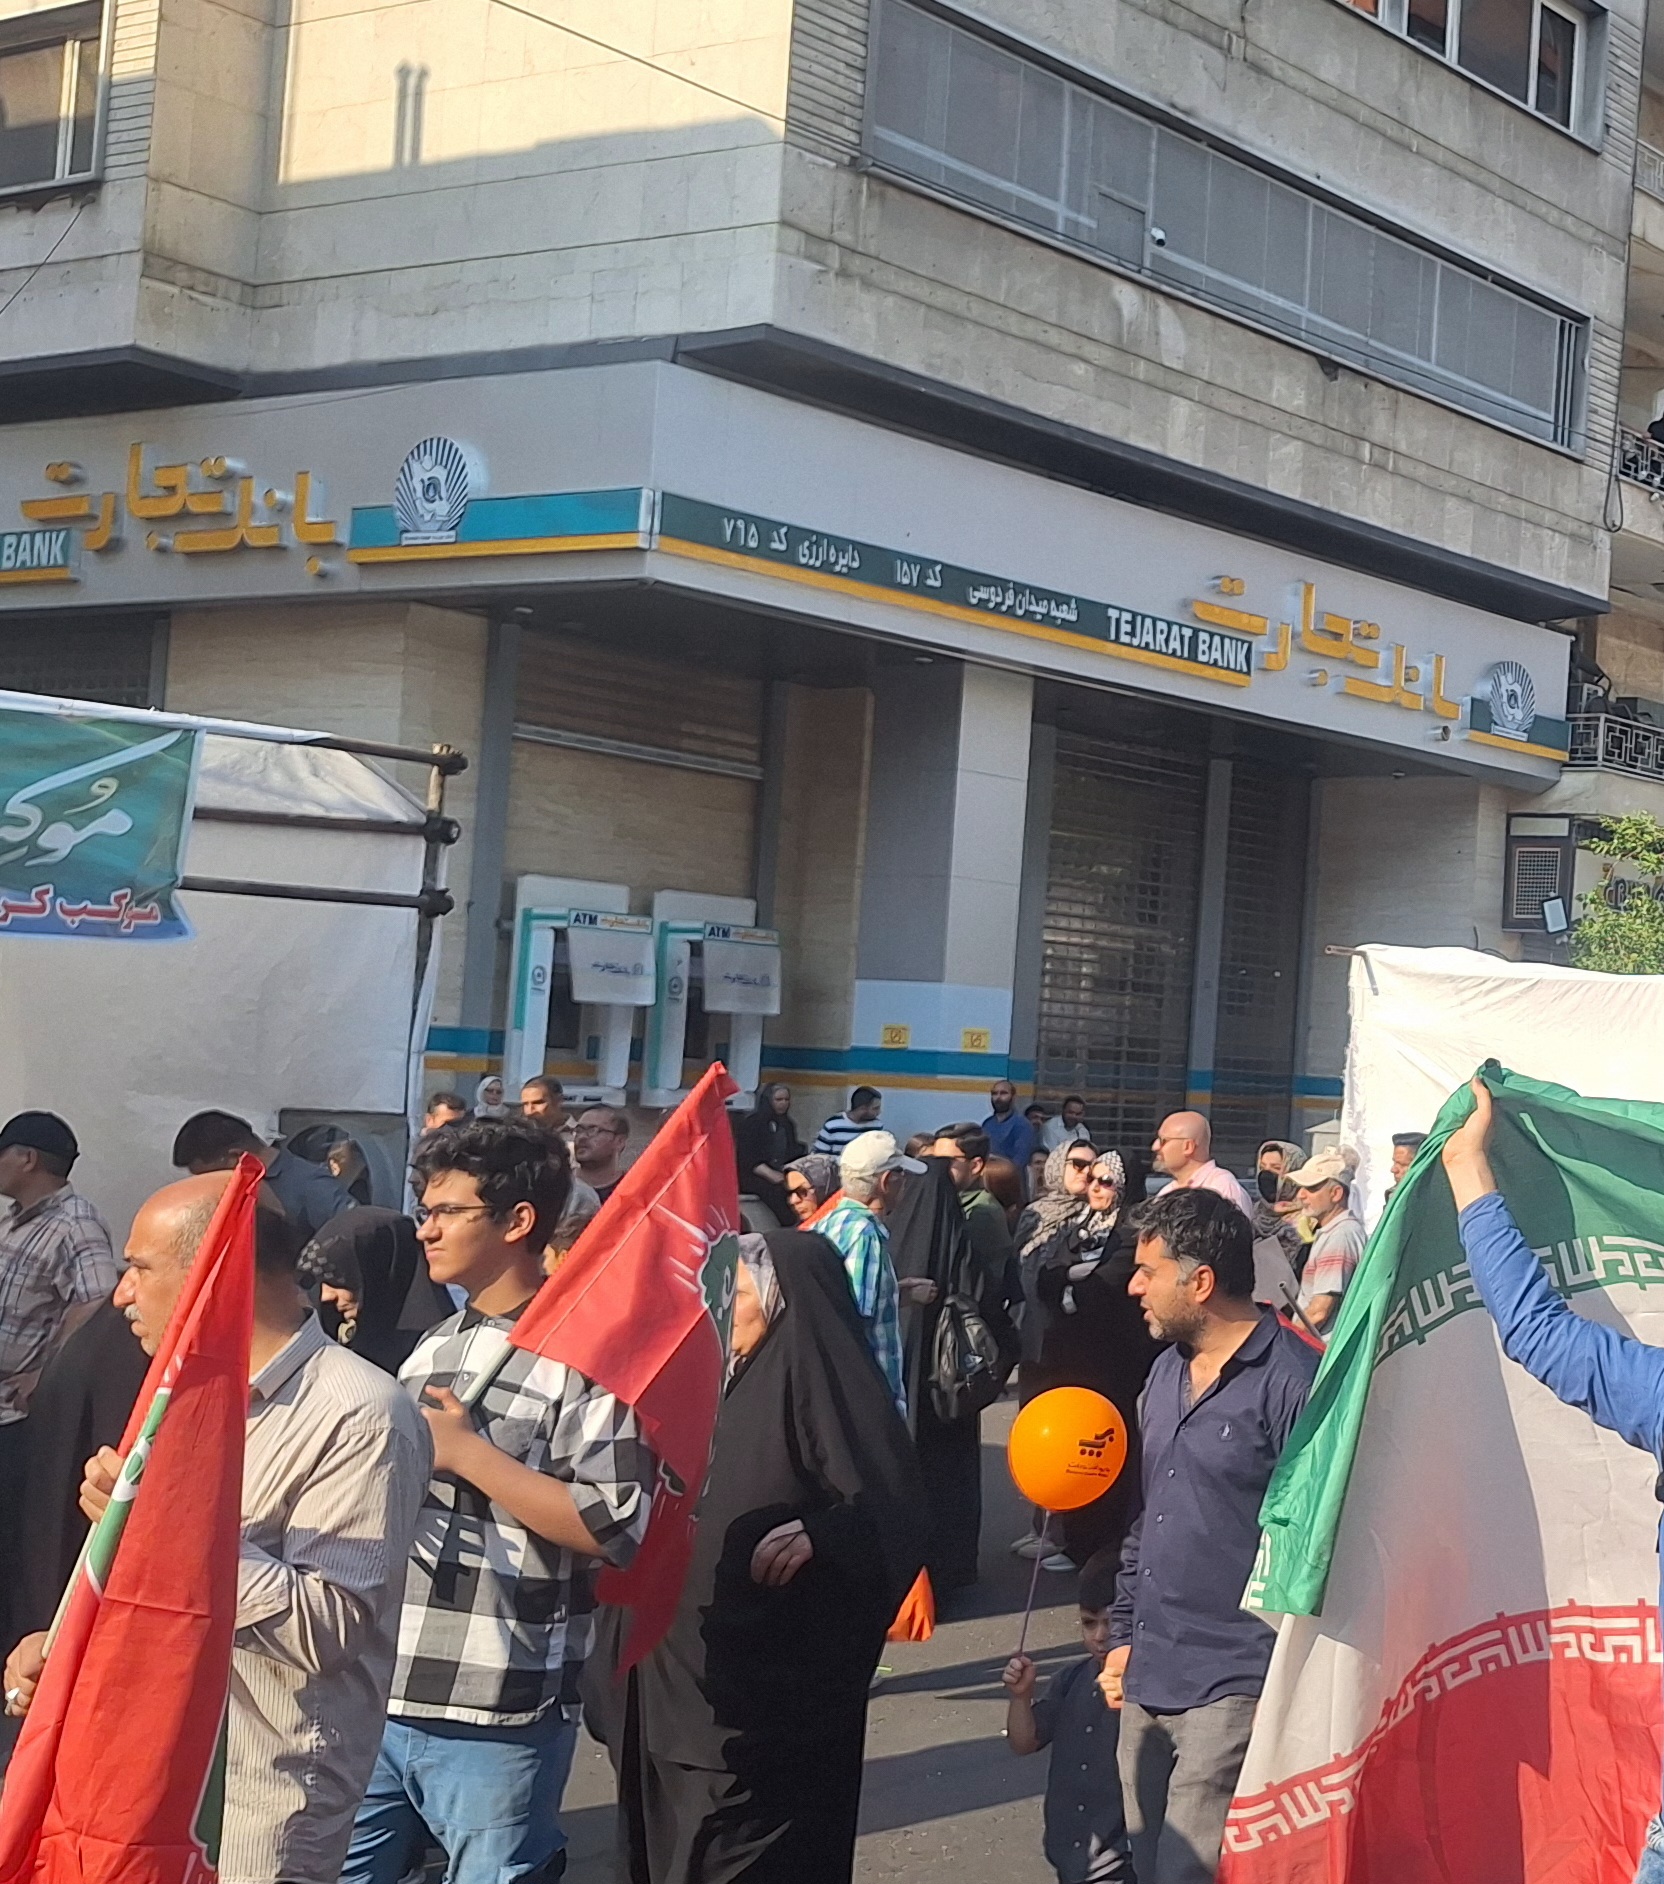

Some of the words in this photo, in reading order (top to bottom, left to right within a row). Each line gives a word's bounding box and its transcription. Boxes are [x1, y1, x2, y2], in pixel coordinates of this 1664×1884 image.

[20, 441, 234, 552] تجارت
[172, 470, 336, 577] بانک
[723, 516, 759, 549] ۷۹۵
[769, 525, 788, 551] کد
[1, 530, 64, 571] BANK
[799, 534, 829, 567] ارزی
[829, 544, 860, 574] دایره
[895, 559, 921, 587] ۱۵۷
[925, 563, 943, 588] کد
[968, 582, 1015, 613] فردوسی
[1015, 588, 1048, 623] میدان
[1051, 598, 1079, 625] شعبه
[1107, 607, 1193, 659] TEJARAT
[1197, 631, 1250, 672] BANK
[1192, 575, 1382, 687] تجارت
[1344, 643, 1462, 742] بانک
[573, 912, 598, 926] ATM
[708, 926, 731, 939] ATM
